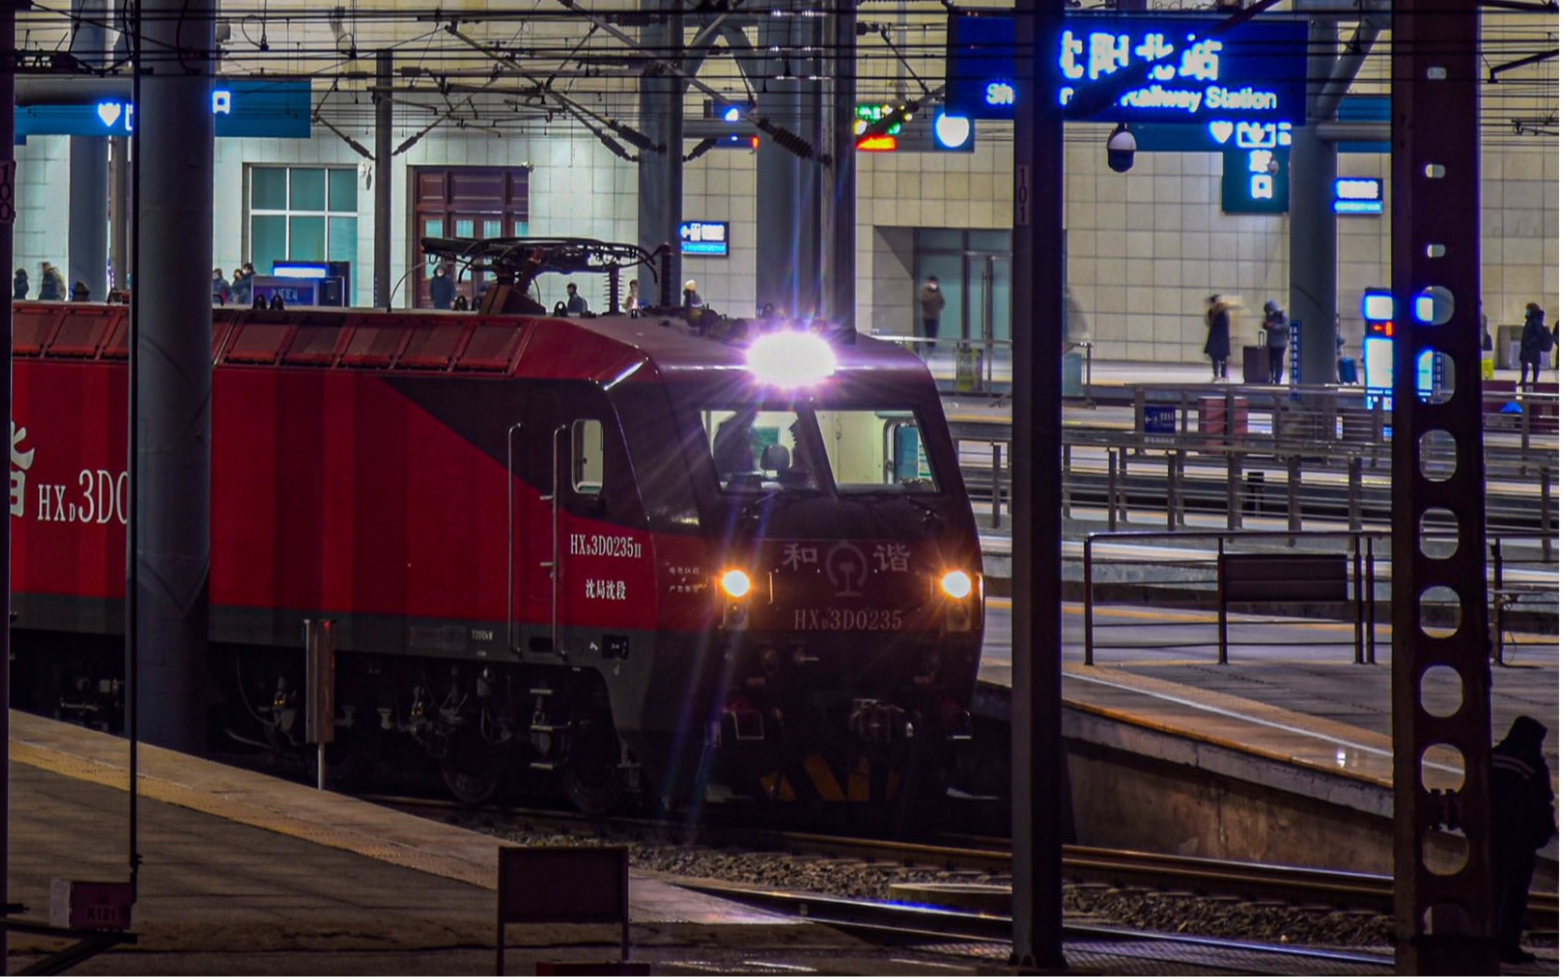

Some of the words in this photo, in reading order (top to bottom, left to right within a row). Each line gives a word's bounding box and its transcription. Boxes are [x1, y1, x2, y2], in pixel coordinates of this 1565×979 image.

[1204, 86, 1277, 109] Station
[37, 469, 128, 524] HXD3D0
[782, 542, 818, 571] 和
[873, 543, 911, 572] 谐
[585, 578, 626, 600] 沈局沈段
[794, 609, 903, 631] HXD3D0235
